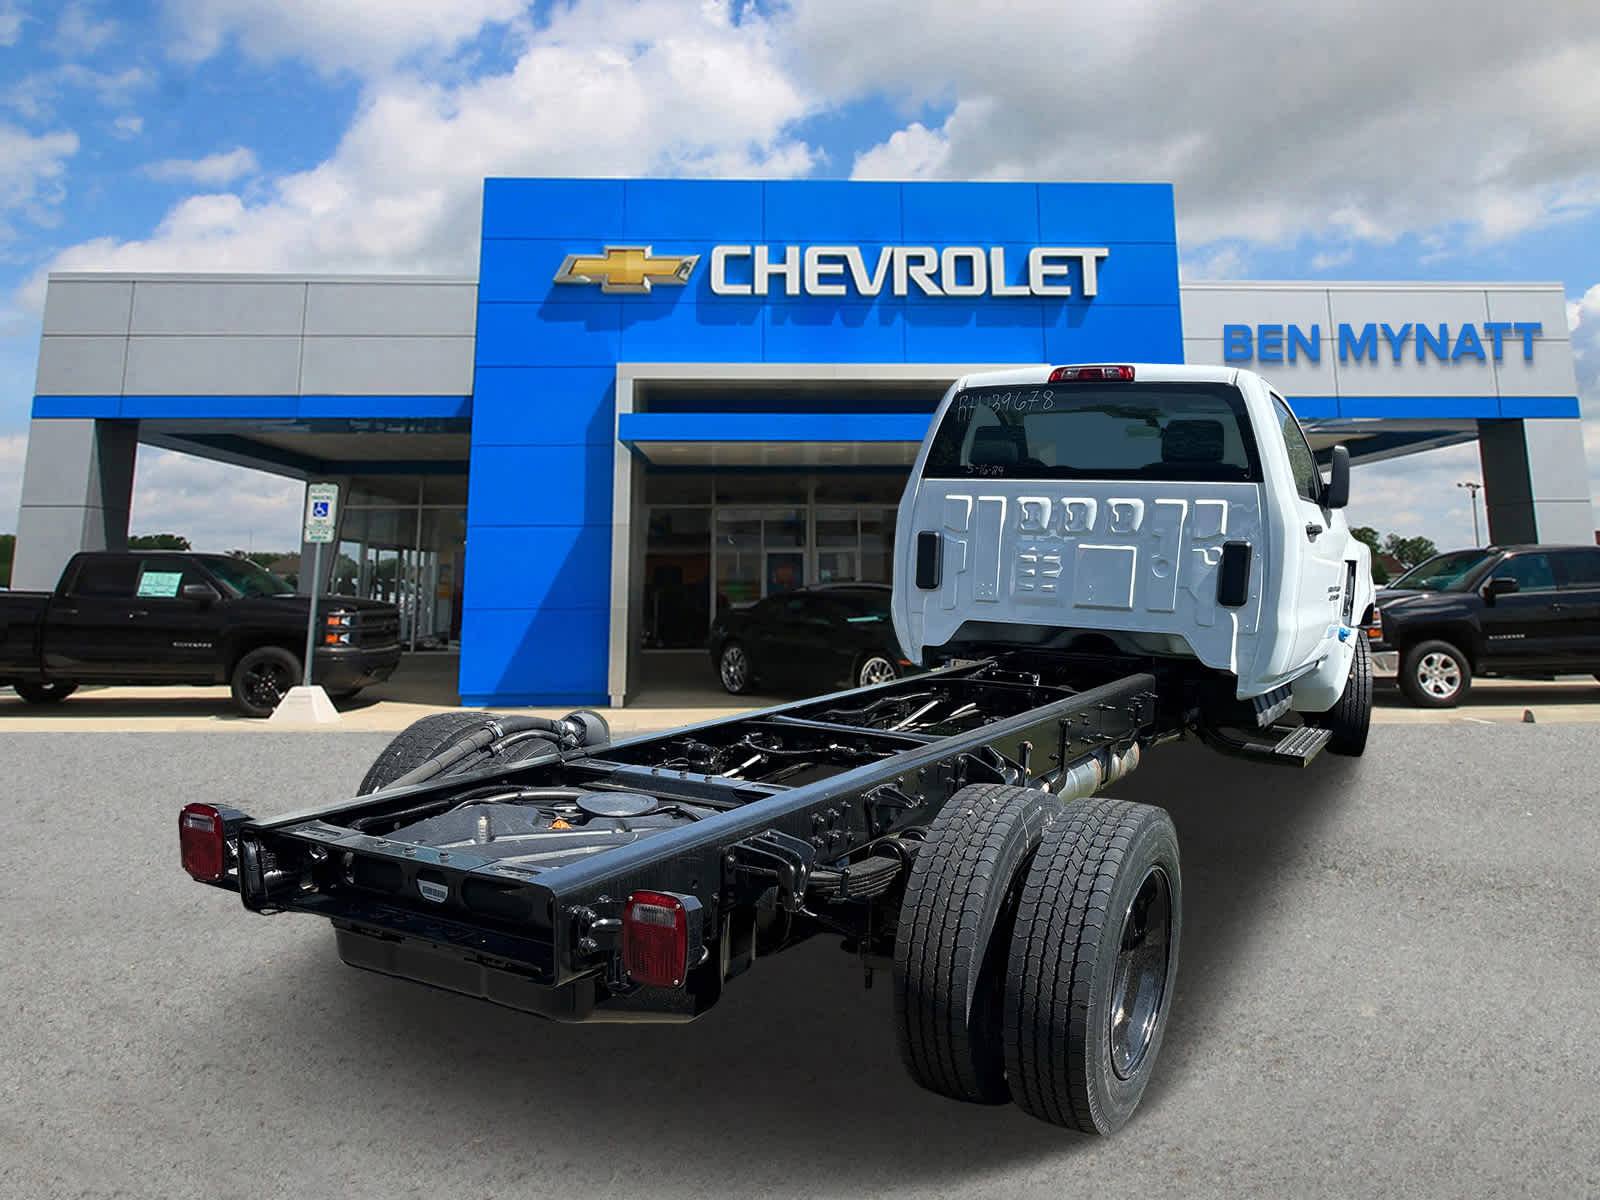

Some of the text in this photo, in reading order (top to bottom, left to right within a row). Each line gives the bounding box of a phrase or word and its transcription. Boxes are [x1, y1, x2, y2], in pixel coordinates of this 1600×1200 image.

[711, 245, 1109, 297] CHEVROLET
[1223, 322, 1543, 362] BEN MYNATT
[991, 389, 1055, 414] 39678
